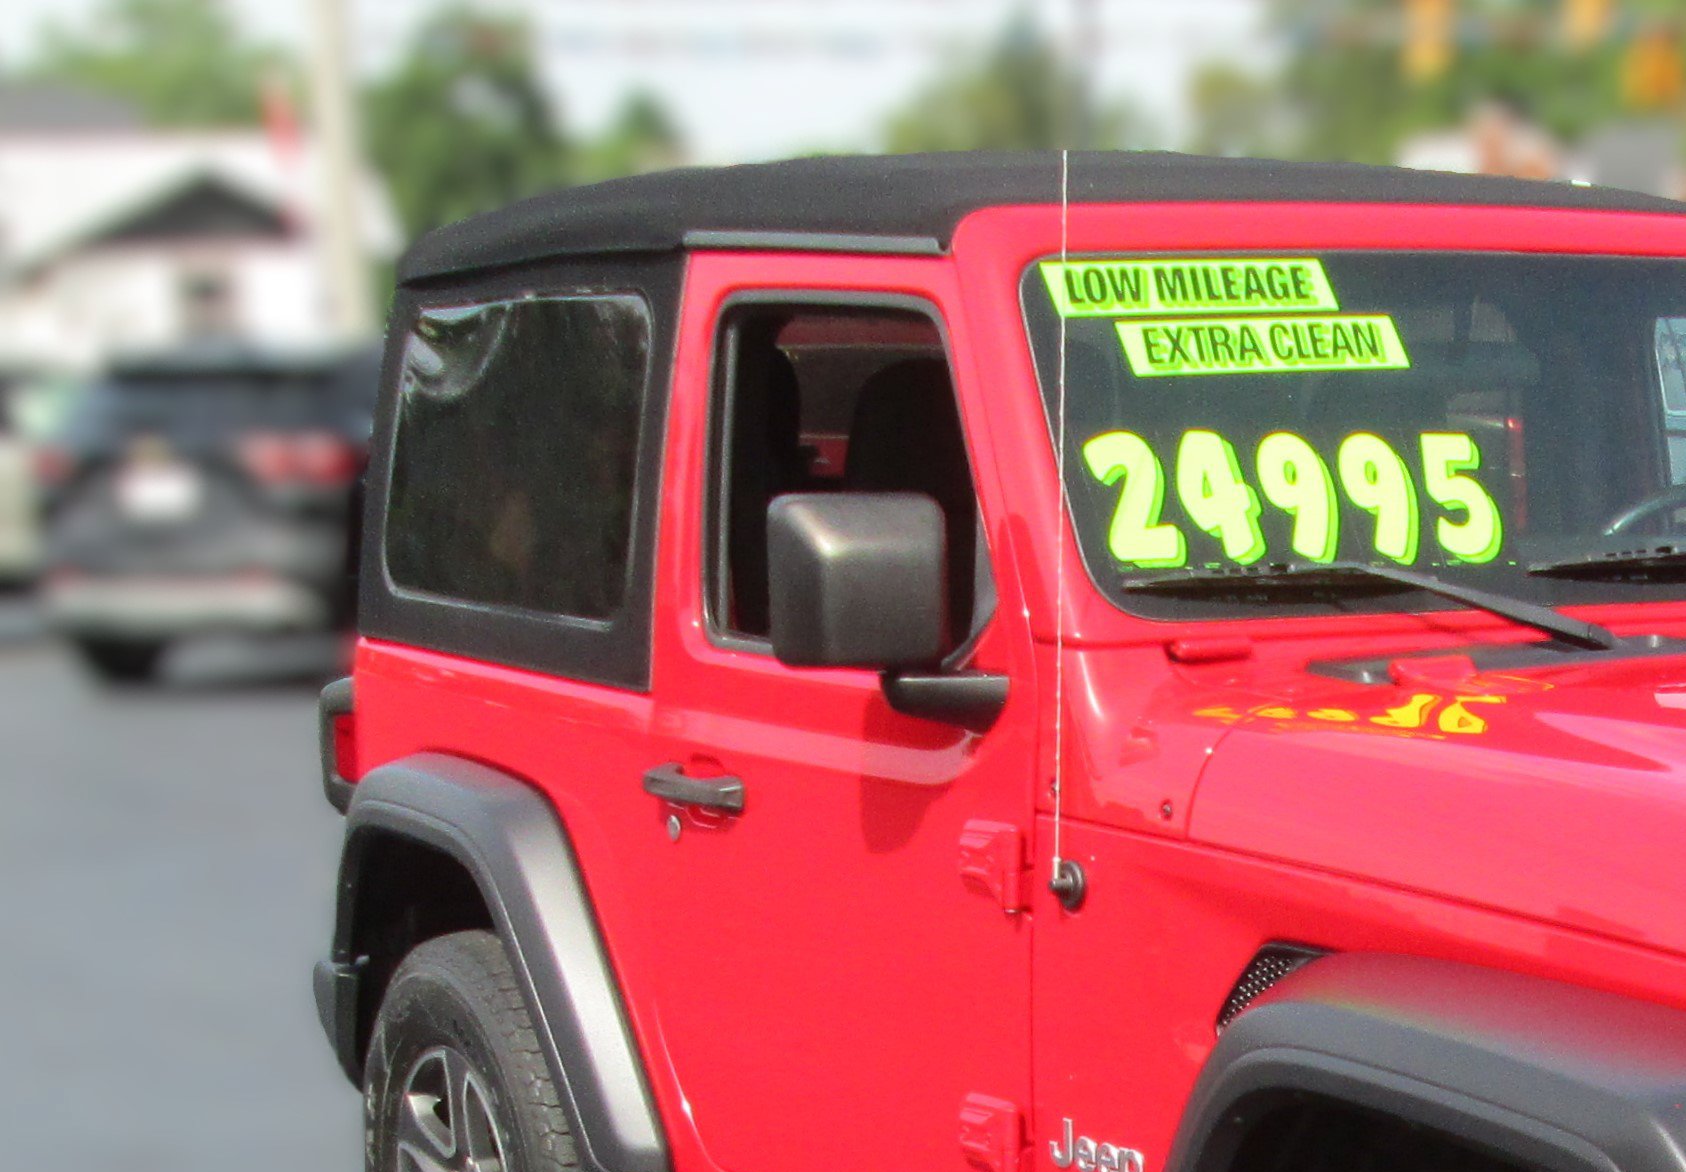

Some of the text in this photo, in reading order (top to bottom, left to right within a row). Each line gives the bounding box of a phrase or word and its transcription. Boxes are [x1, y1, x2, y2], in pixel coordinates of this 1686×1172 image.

[1062, 264, 1313, 306] LOW MILEAGE
[1142, 319, 1383, 365] EXTRA CLEAN
[1082, 429, 1503, 567] 24995
